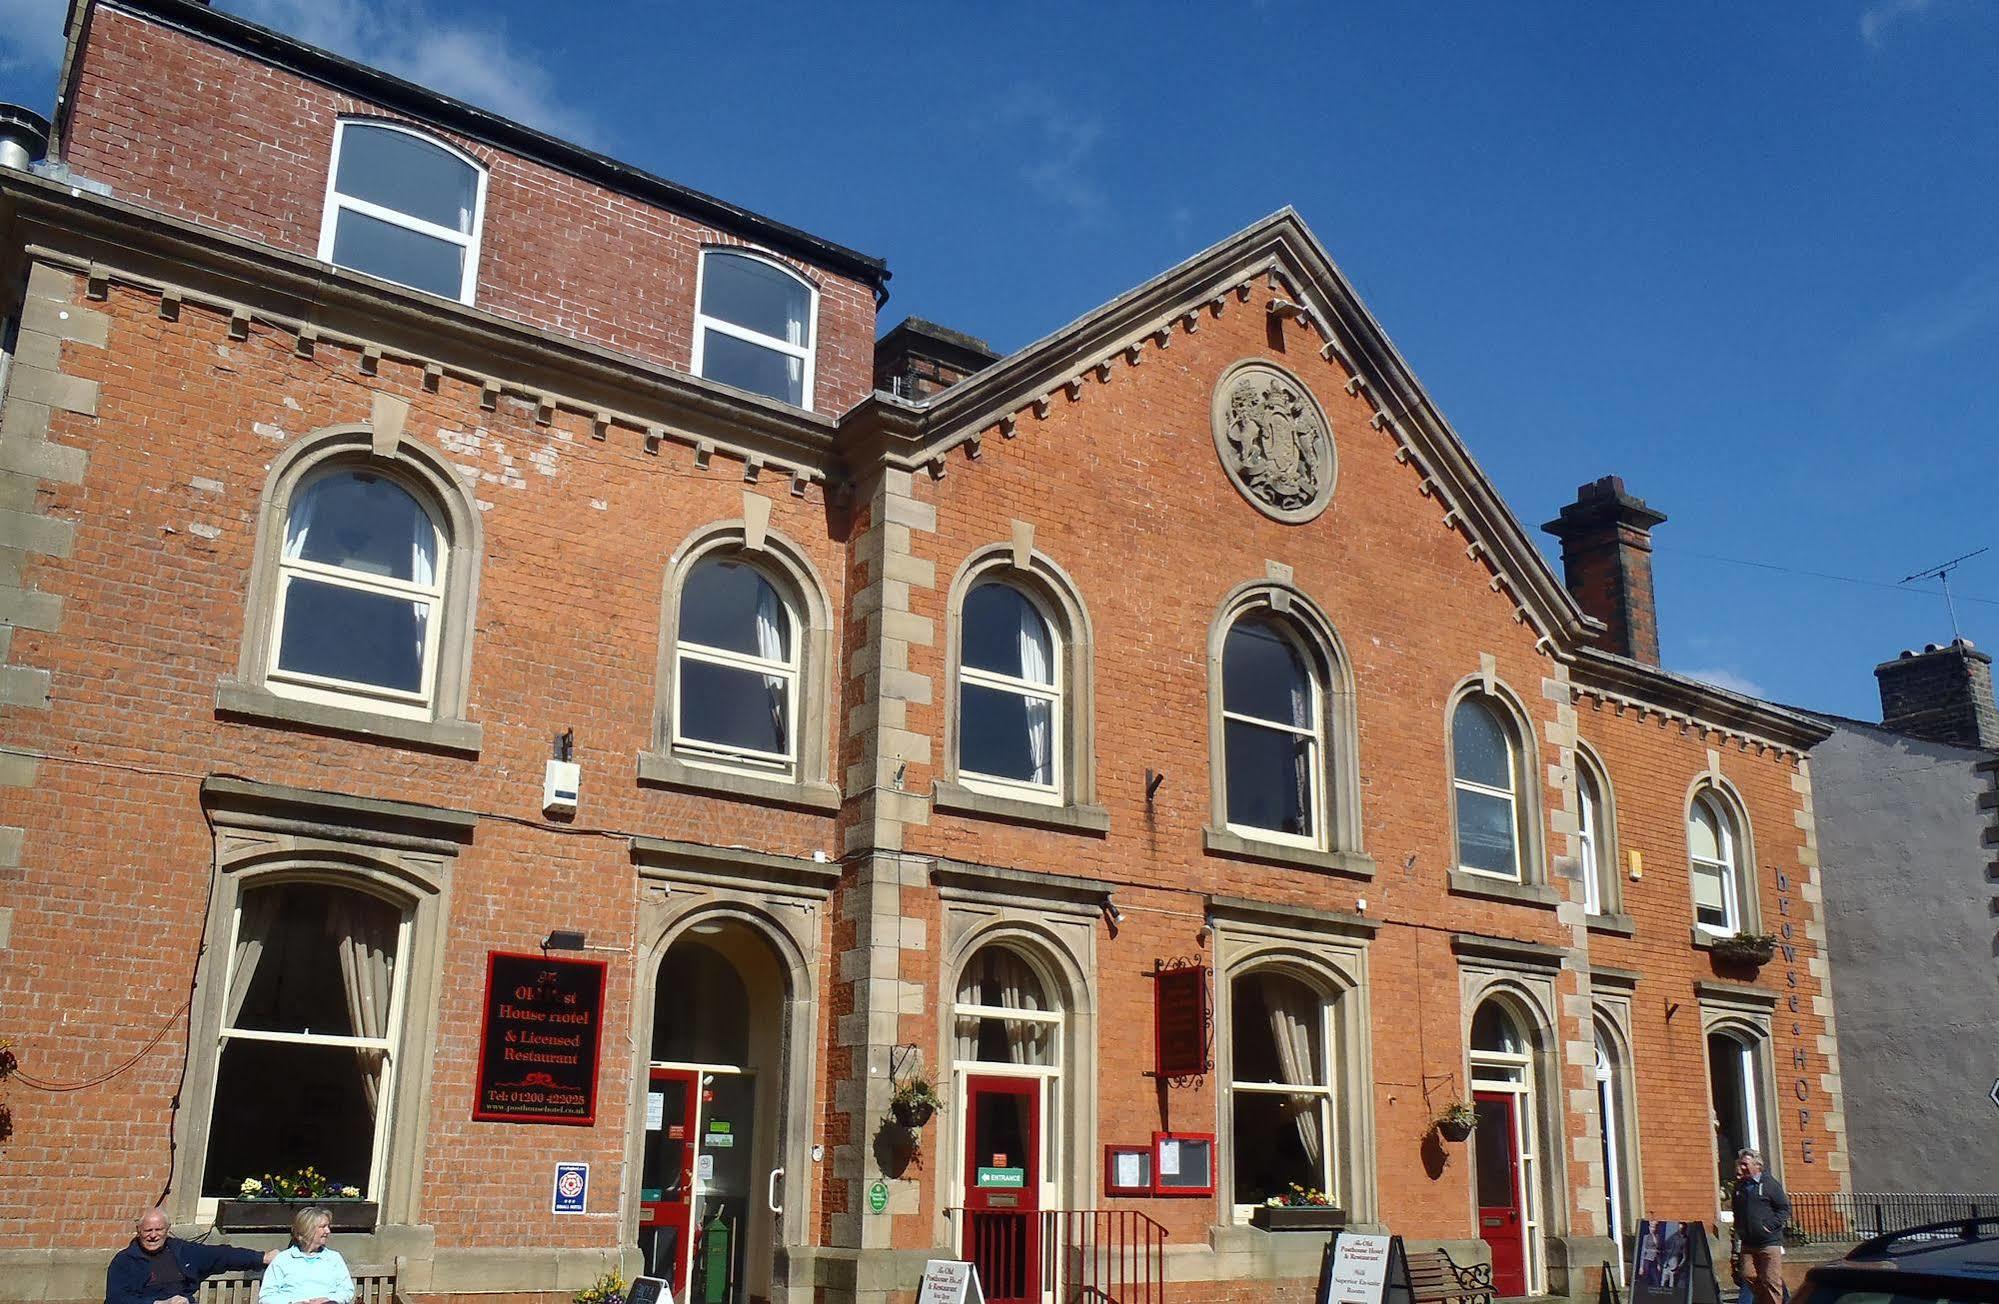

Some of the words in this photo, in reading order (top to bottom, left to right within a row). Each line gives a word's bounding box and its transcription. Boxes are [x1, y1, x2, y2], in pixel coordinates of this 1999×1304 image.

[498, 1004, 546, 1022] House
[504, 1031, 517, 1042] &
[520, 1031, 582, 1048] Licensed
[504, 1048, 579, 1065] Restaurant
[487, 1089, 509, 1102] Tel:
[1793, 1046, 1815, 1164] HOPE
[990, 1174, 1021, 1182] ENTRANCE
